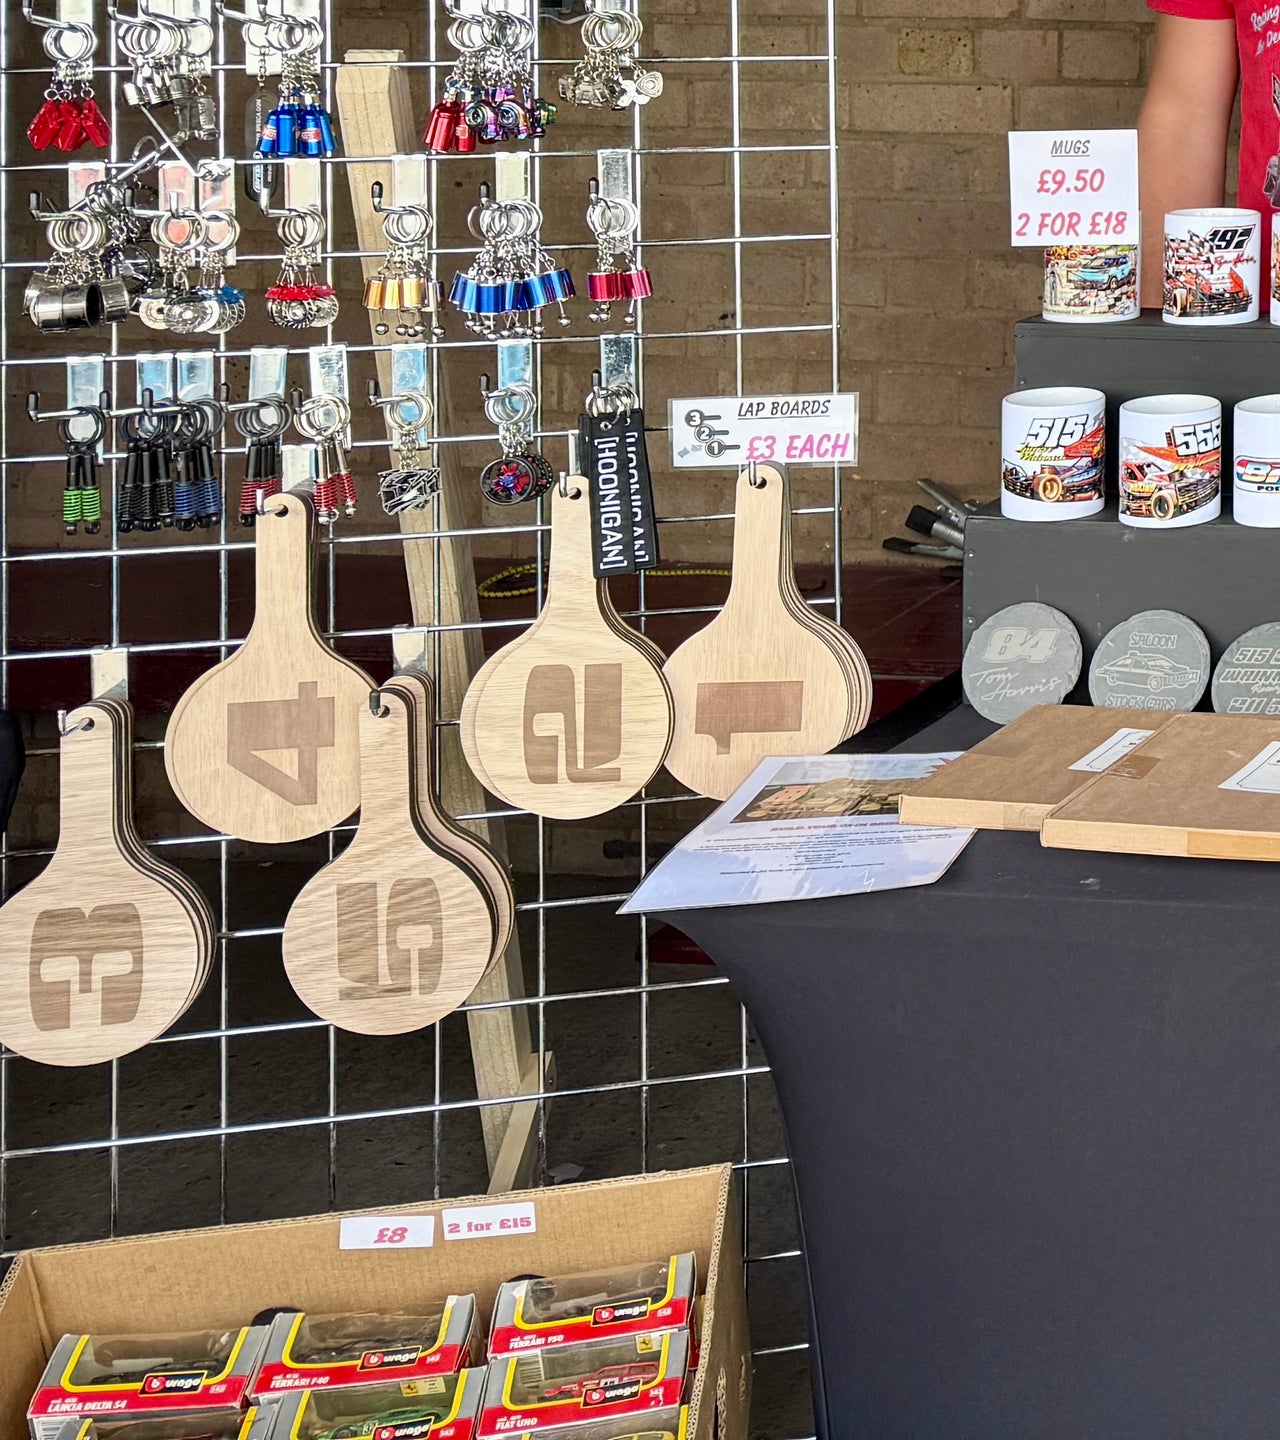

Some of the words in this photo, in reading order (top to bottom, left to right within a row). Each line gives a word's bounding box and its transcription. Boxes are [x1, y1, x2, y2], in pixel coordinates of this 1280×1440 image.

[1050, 139, 1092, 156] MUGS
[1036, 167, 1106, 195] £9.50
[1016, 214, 1032, 239] 2
[1034, 212, 1086, 238] FOR
[1088, 210, 1128, 237] £18
[737, 403, 768, 418] LAP
[769, 400, 831, 417] BOARDS
[1024, 414, 1089, 448] 515
[747, 436, 775, 461] £3
[785, 434, 850, 459] EACH
[982, 626, 1061, 664] 84
[1129, 632, 1177, 649] SALOON
[1232, 647, 1273, 665] 515
[970, 667, 1014, 687] Tom
[981, 676, 1062, 701] Harris
[1105, 694, 1143, 709] STOCK
[1145, 694, 1176, 711] CARS
[522, 663, 623, 785] 2
[694, 680, 805, 756] 1
[226, 681, 336, 806] 4
[337, 877, 443, 1001] 5
[28, 902, 144, 1032] 3
[447, 1222, 461, 1235] 2
[466, 1220, 494, 1234] for
[499, 1215, 532, 1230] £15
[373, 1226, 408, 1245] £8
[509, 1337, 546, 1350] FERRARI
[270, 1377, 310, 1389] FERRARI
[47, 1403, 83, 1414] LANCIA
[84, 1401, 112, 1412] DELTA
[496, 1419, 516, 1431] FIAT
